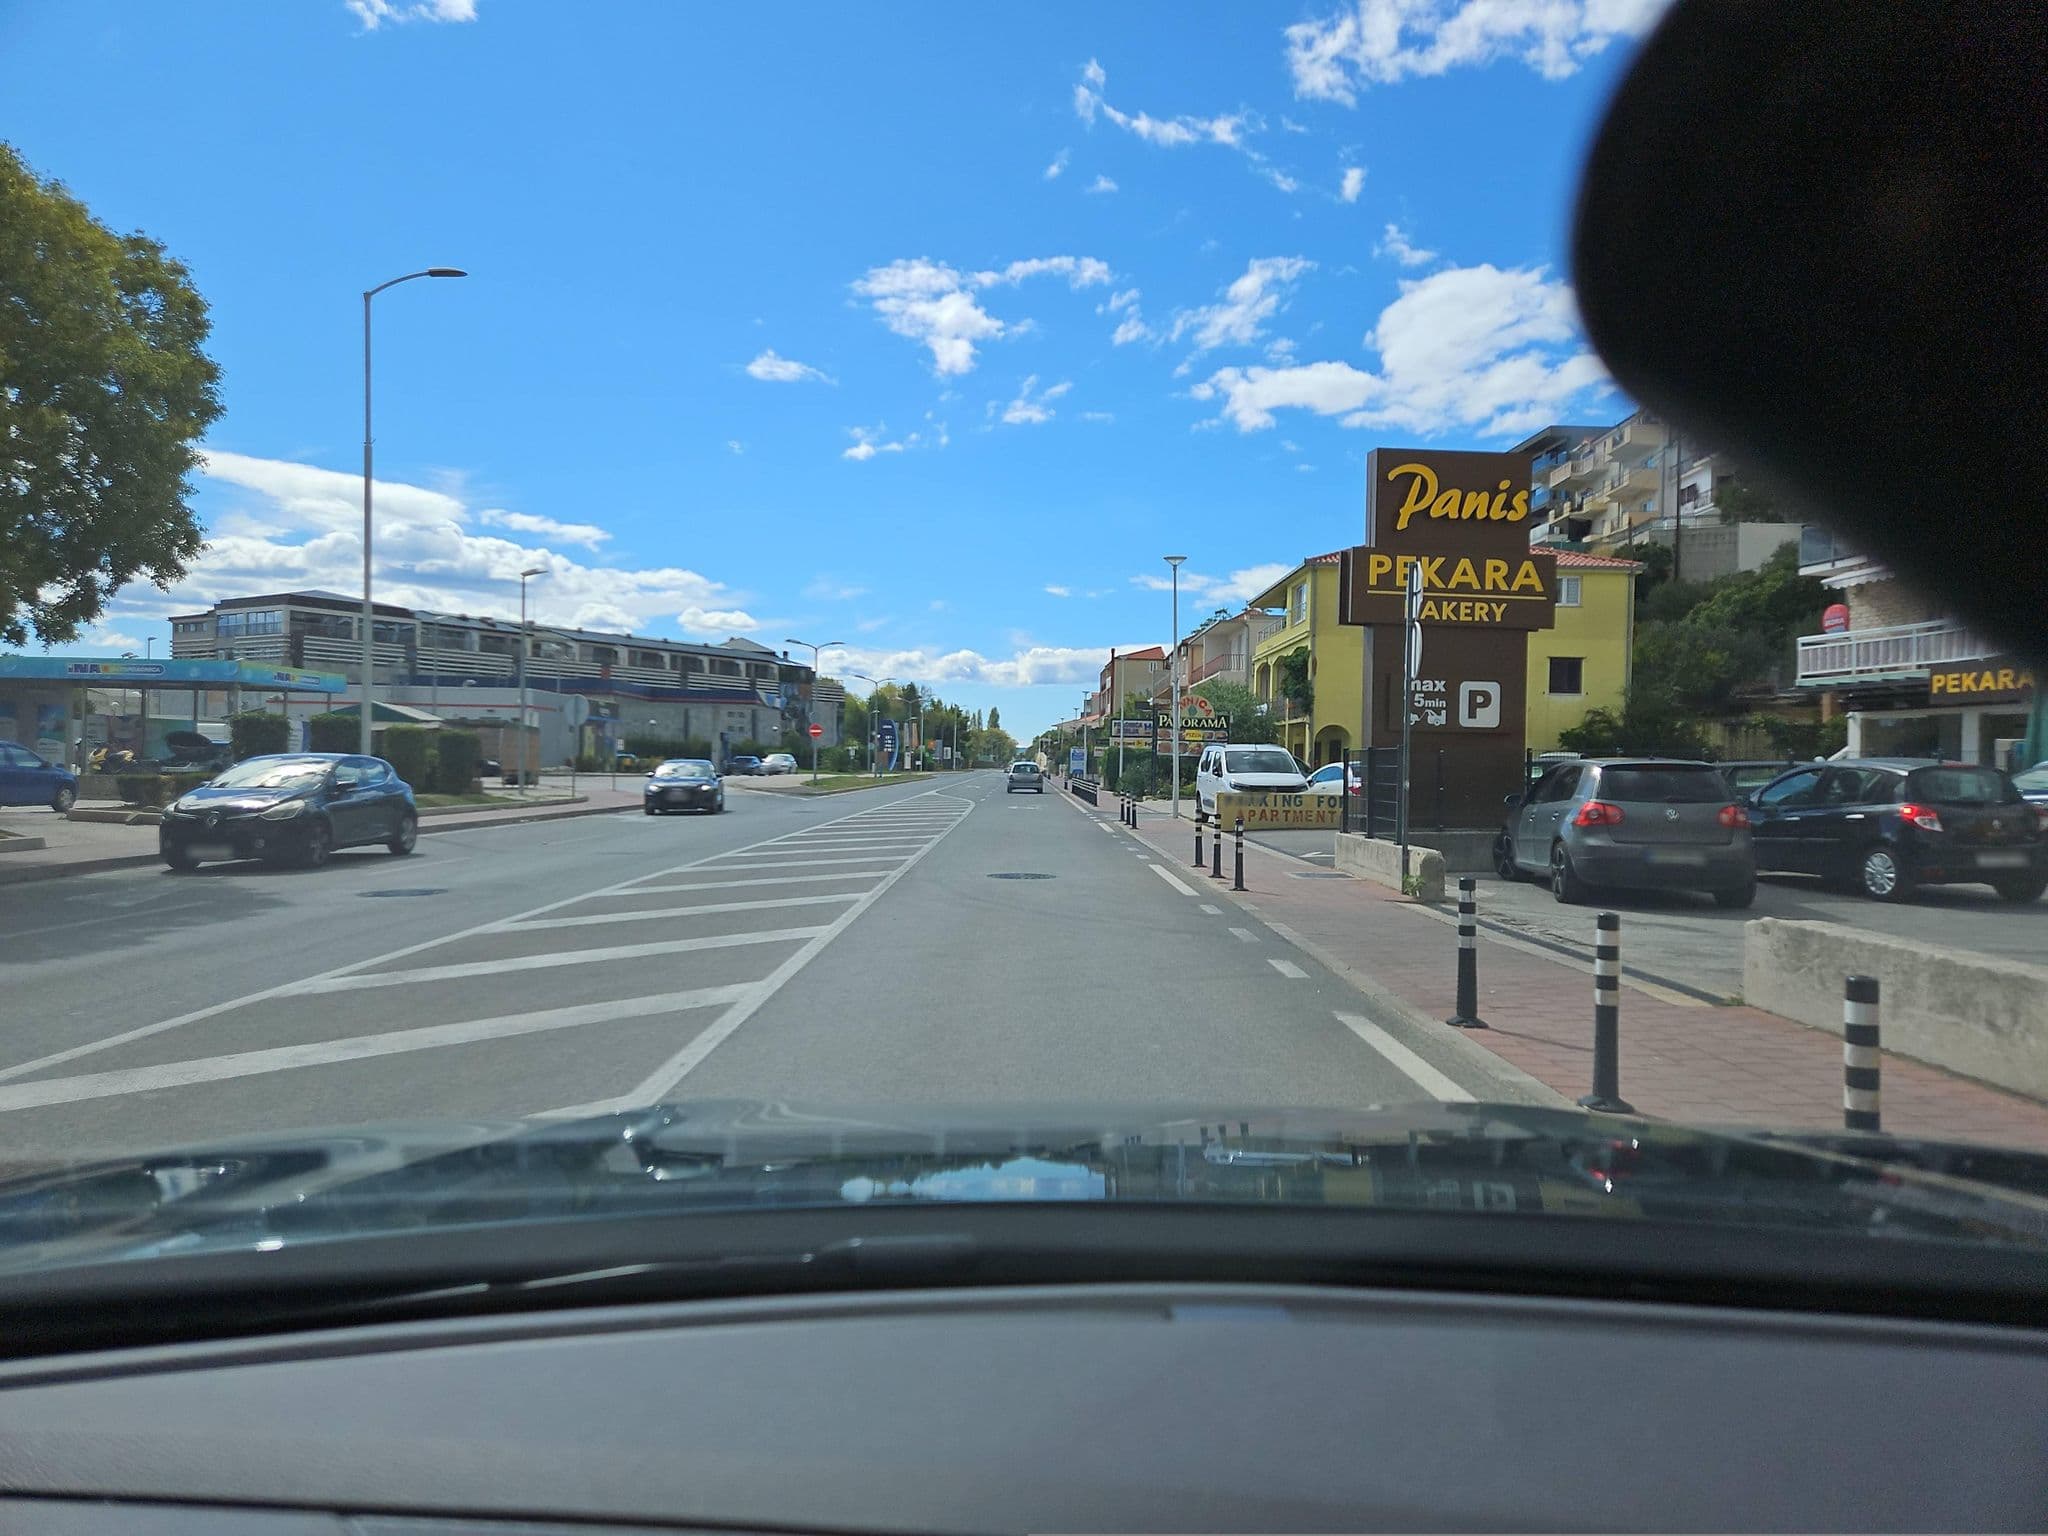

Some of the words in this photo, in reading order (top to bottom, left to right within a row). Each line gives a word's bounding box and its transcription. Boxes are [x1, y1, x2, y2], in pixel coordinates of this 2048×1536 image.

[1388, 463, 1528, 530] Panis
[1368, 554, 1544, 593] PEKARA
[1405, 600, 1507, 622] AKERY
[1468, 690, 1492, 719] P
[1159, 714, 1228, 729] PAORAMA
[1317, 795, 1343, 809] FO
[1236, 808, 1343, 823] APARTMENT
